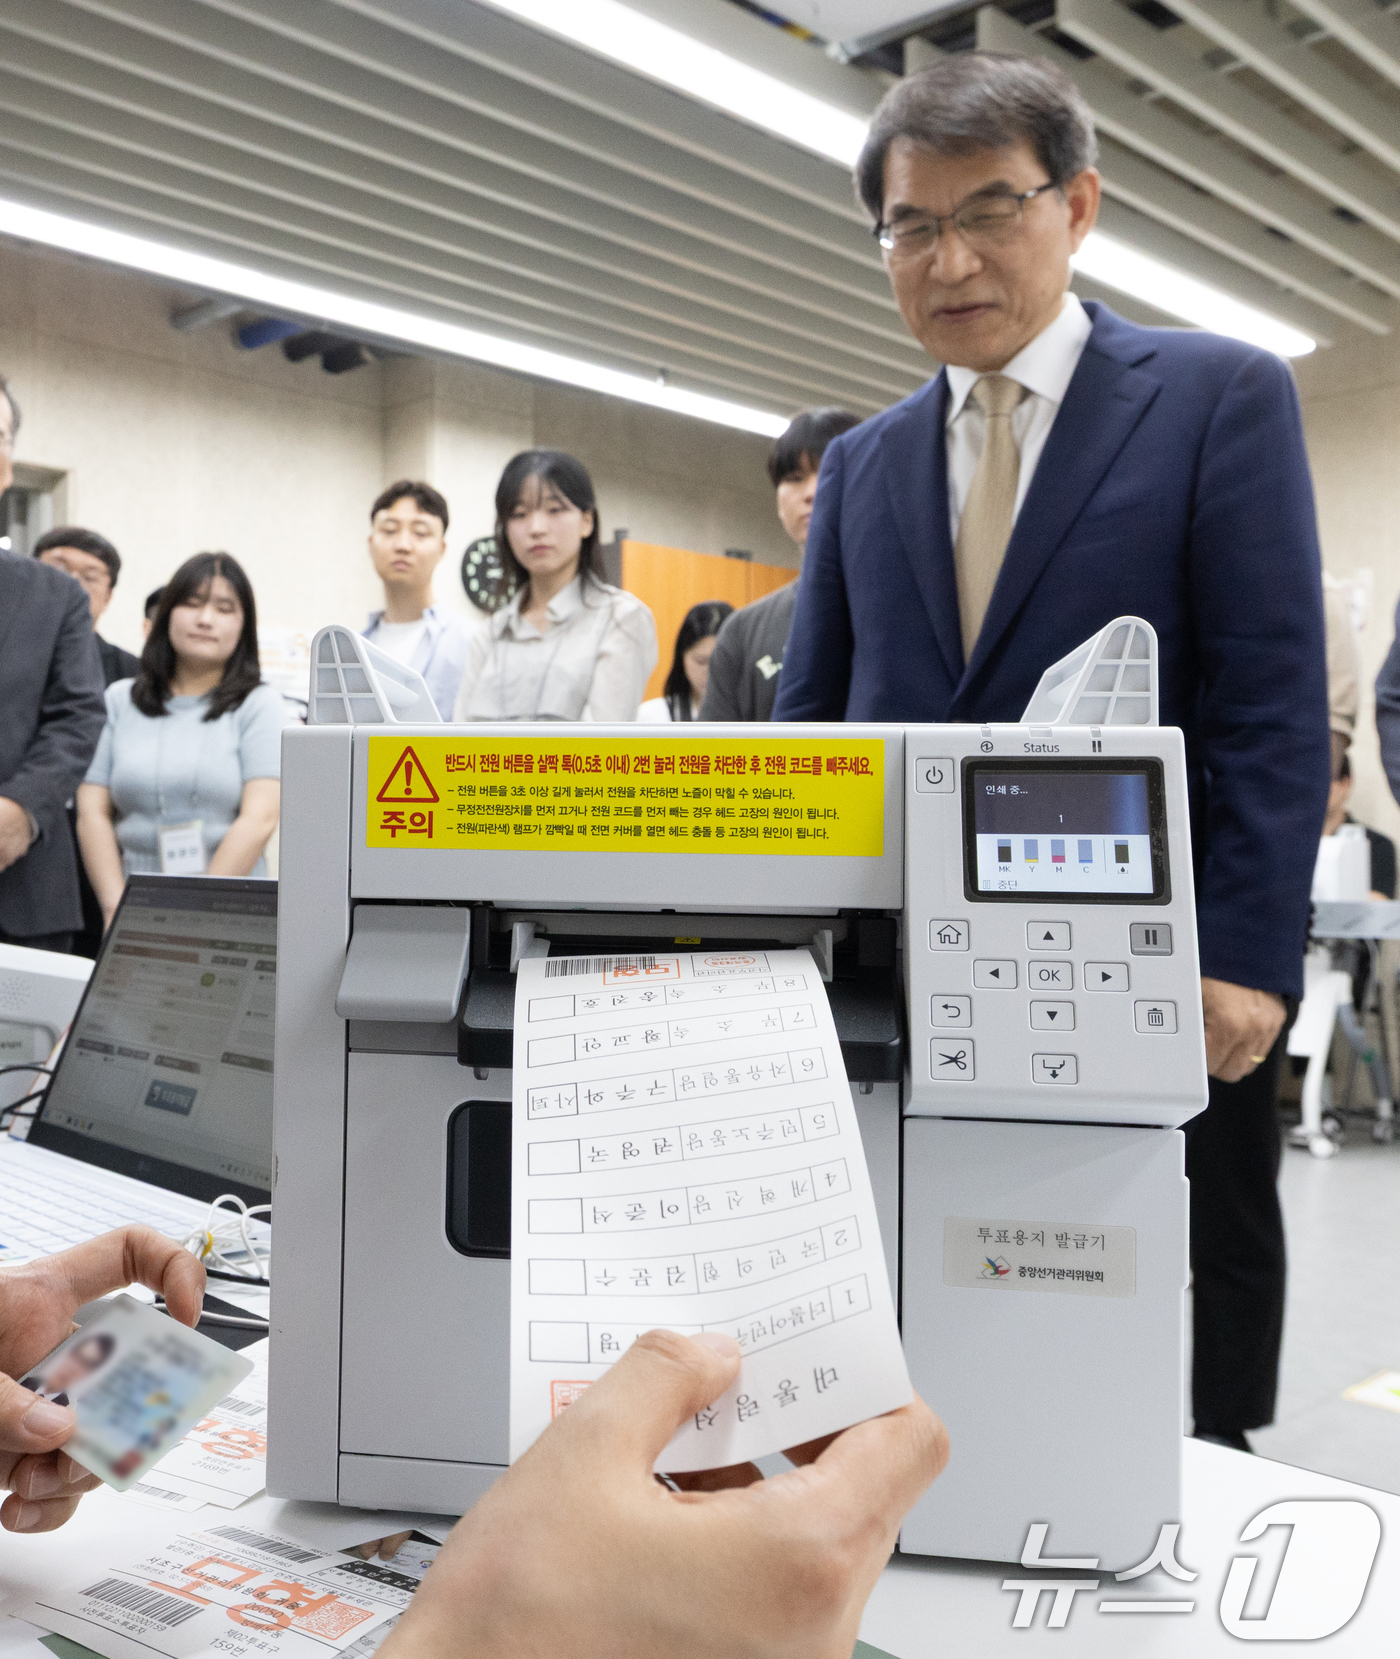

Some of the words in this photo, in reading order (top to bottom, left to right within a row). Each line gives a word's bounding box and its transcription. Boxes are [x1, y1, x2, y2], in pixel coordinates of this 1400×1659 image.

[1024, 742, 1060, 753] Status
[445, 753, 476, 773] 반드시
[479, 753, 500, 773] 전원
[504, 753, 534, 773] 버튼을
[537, 754, 559, 774] 살짝
[561, 754, 602, 774] 톡(0.5초
[606, 754, 630, 775] 이내)
[634, 755, 650, 774] 2번
[654, 755, 675, 774] 눌러
[679, 755, 711, 775] 전원을
[714, 755, 747, 775] 차단한
[750, 756, 761, 775] 후
[764, 756, 786, 776] 전원
[789, 756, 822, 776] 코드를
[826, 756, 874, 776] 빼주세요.
[457, 786, 476, 797] 전원
[479, 786, 508, 797] 버튼을
[510, 786, 528, 797] 3초
[530, 786, 549, 797] 이상
[552, 786, 571, 798] 길게
[574, 786, 604, 798] 눌러서
[606, 786, 636, 798] 전원을
[639, 787, 678, 799] 차단하면
[682, 787, 712, 799] 노즐이
[715, 787, 736, 799] 막힐
[738, 788, 749, 799] 수
[752, 788, 796, 800] 있습니다.
[986, 784, 1007, 795] 인쇄
[1010, 784, 1028, 796] 중...
[456, 804, 533, 816] 무정전전원장치를
[536, 805, 556, 816] 먼저
[558, 806, 587, 816] 끄거나
[590, 806, 611, 817] 전원
[613, 806, 643, 817] 코드를
[646, 806, 666, 818] 먼저
[669, 806, 690, 818] 빼는
[692, 807, 712, 819] 경우
[715, 807, 736, 818] 헤드
[738, 807, 769, 819] 고장의
[772, 808, 803, 819] 원인이
[806, 808, 840, 820] 됩니다.
[1058, 814, 1064, 824] 1
[380, 810, 434, 838] 주의
[456, 822, 510, 835] 전원(파란색)
[513, 823, 542, 836] 램프가
[545, 824, 574, 836] 깜빡일
[578, 824, 587, 836] 때
[590, 824, 610, 836] 전면
[613, 824, 643, 836] 커버를
[646, 826, 666, 837] 열면
[668, 826, 689, 837] 헤드
[692, 826, 712, 838] 충돌
[715, 826, 726, 838] 등
[728, 826, 759, 838] 고장의
[762, 827, 793, 839] 원인이
[796, 827, 830, 840] 됩니다.
[1082, 866, 1090, 874] C
[998, 880, 1018, 890] 중단
[784, 978, 796, 988] 8
[1038, 969, 1061, 982] OK
[792, 1011, 806, 1023] 7
[582, 1030, 661, 1053] 황교안
[800, 1058, 814, 1072] 6
[680, 1061, 787, 1091] 자유통일당
[585, 1079, 670, 1106] 구주와
[531, 1094, 578, 1112] 사퇴
[812, 1114, 827, 1129] 5
[687, 1119, 799, 1150] 민주노동당
[586, 1136, 674, 1162] 권영국
[824, 1173, 838, 1188] 4
[692, 1179, 809, 1215] 개혁신당
[592, 1202, 680, 1224] 이준석
[834, 1229, 848, 1246] 2
[976, 1227, 1045, 1248] 투표용지
[1054, 1232, 1106, 1251] 발급기
[704, 1241, 820, 1282] 국민의힘
[593, 1266, 687, 1287] 김문수
[1018, 1266, 1104, 1282] 중앙선거관리위원회
[844, 1288, 855, 1305] 1
[734, 1301, 828, 1347] 더불어민주
[245, 1602, 284, 1618] 06050
[208, 1638, 250, 1658] 159번
[224, 1629, 280, 1654] 제02투표구
